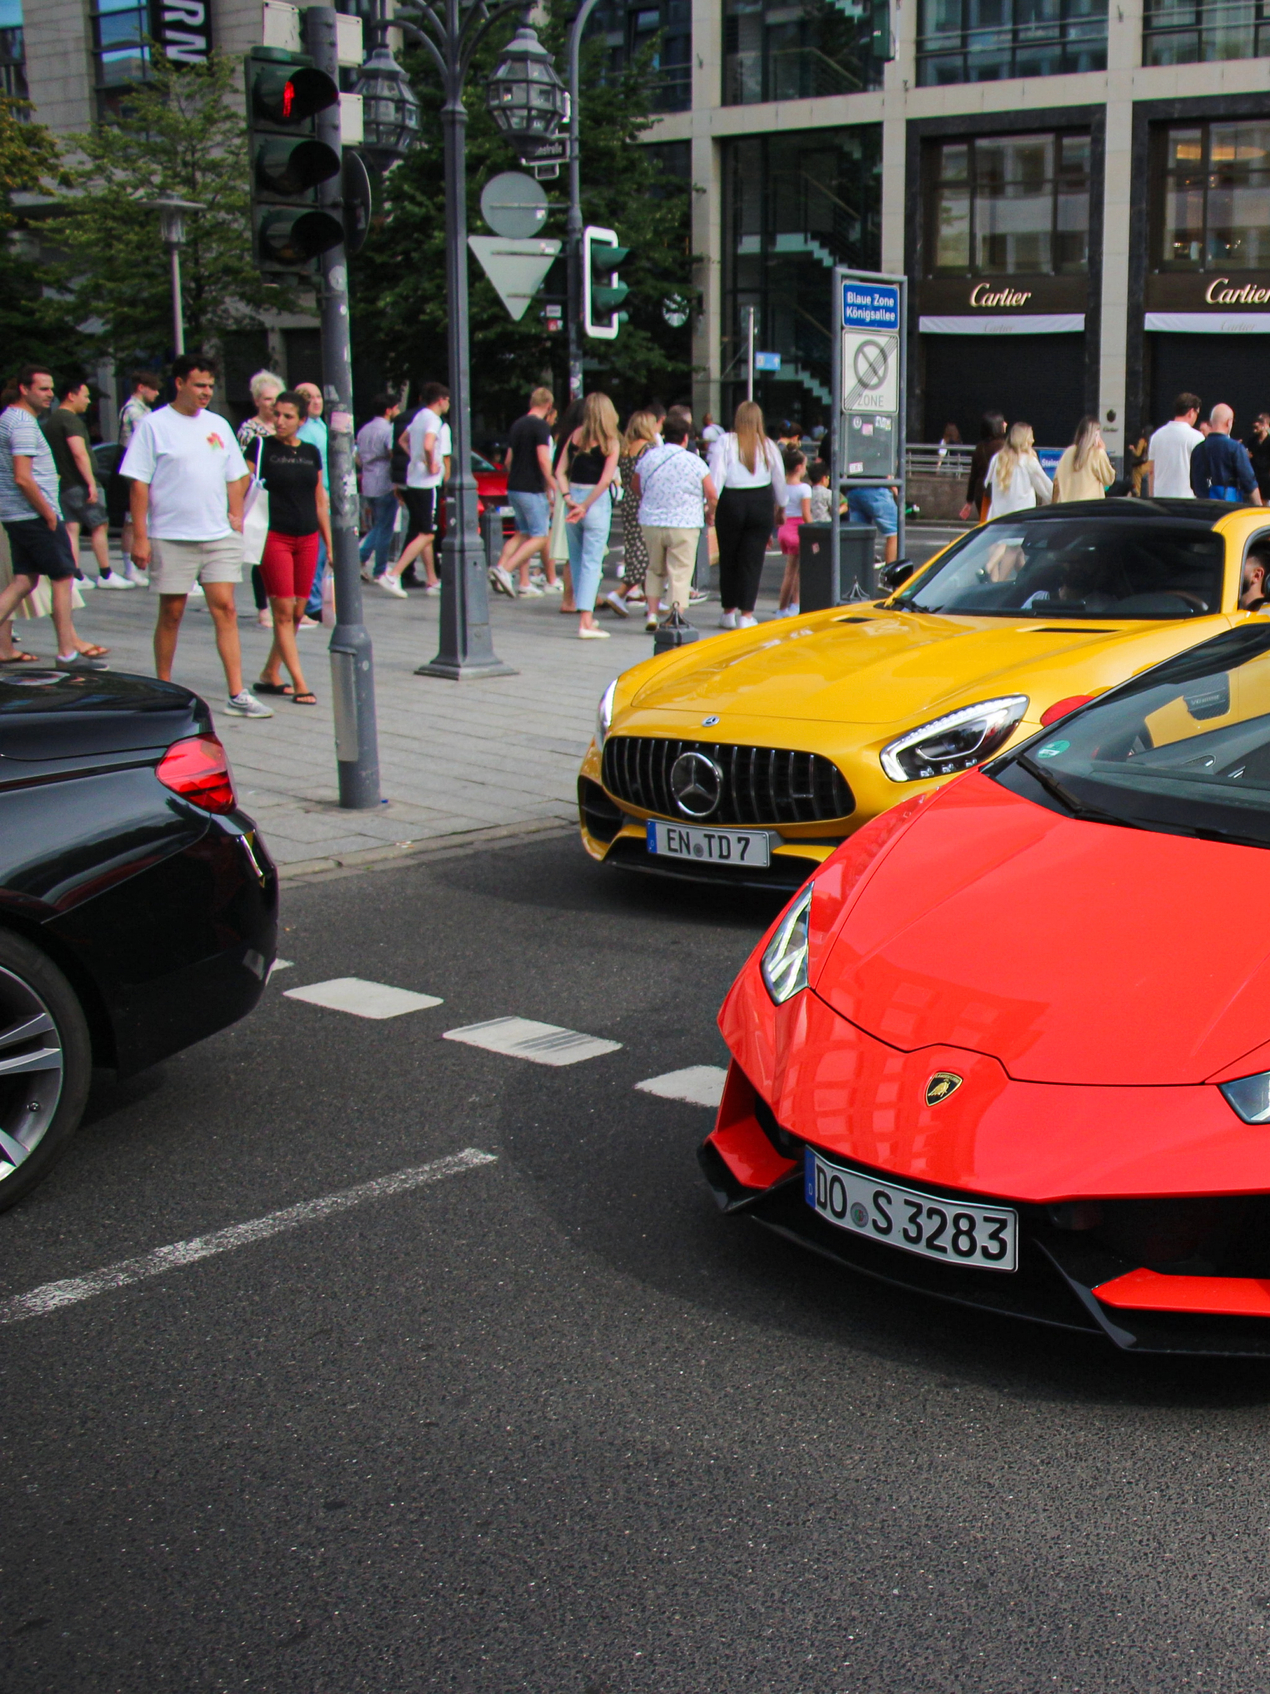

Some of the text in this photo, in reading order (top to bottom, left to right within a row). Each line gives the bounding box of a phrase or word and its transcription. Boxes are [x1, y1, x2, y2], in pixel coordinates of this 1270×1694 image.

[847, 291, 895, 308] Blaue Zone
[970, 282, 1032, 308] Cartier
[846, 305, 896, 323] Königsallee
[857, 393, 885, 408] ZONE
[666, 828, 751, 861] EN TD 7
[816, 1163, 1009, 1261] DO S 3283
